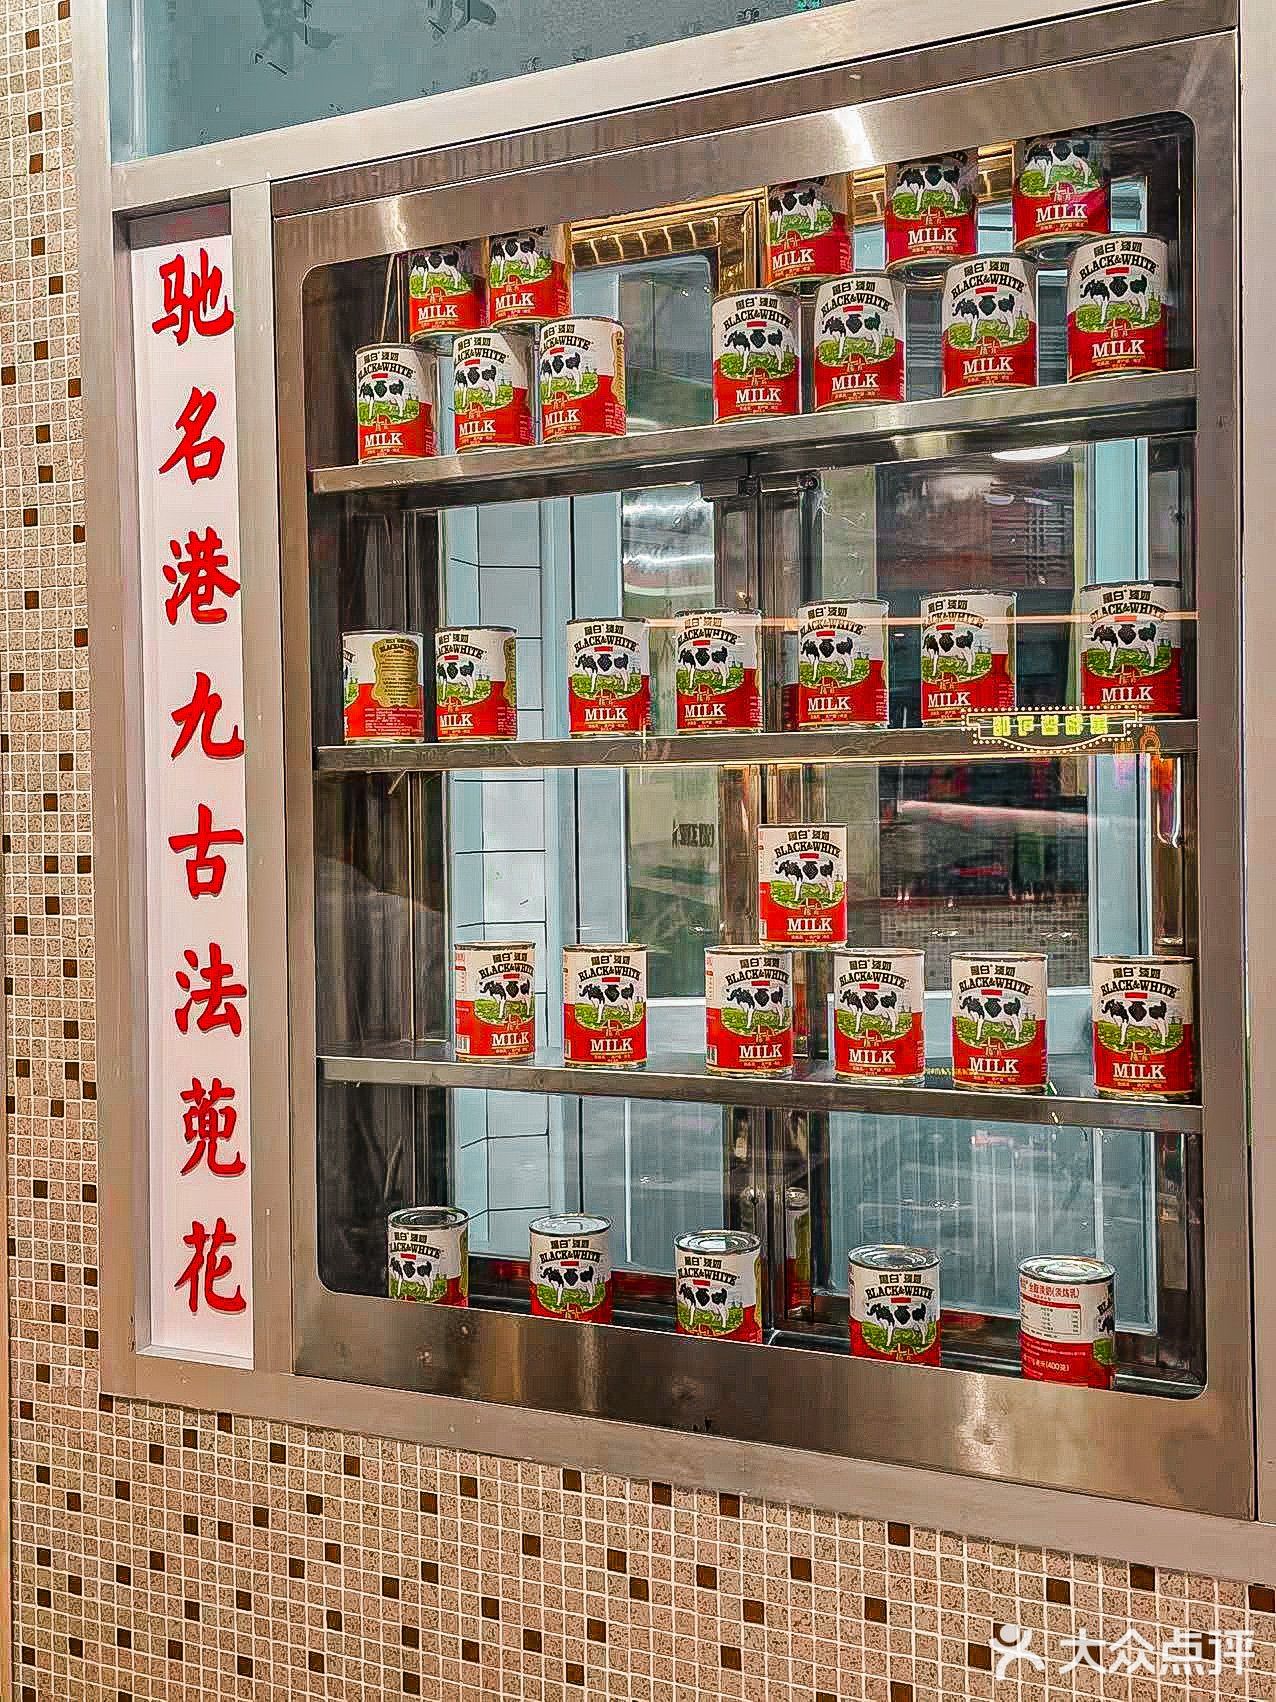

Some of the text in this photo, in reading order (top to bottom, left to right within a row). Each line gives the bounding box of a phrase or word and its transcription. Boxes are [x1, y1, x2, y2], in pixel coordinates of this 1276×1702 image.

[1036, 203, 1087, 223] MILK
[908, 227, 957, 246] MILK
[772, 249, 815, 270] MILK
[1079, 253, 1157, 281] BLACK&WHITE
[951, 273, 1025, 300] BLACK&WHITE
[495, 293, 534, 310] MILK
[821, 293, 892, 316] BLACK&WHITE
[418, 304, 458, 320] MILK
[723, 308, 793, 330] BLACK&WHITE
[540, 336, 591, 354] ACK&WHITE
[1092, 339, 1145, 360] MILK
[454, 348, 506, 365] ACK&WHITE
[963, 356, 1014, 375] MILK
[831, 373, 879, 392] MILK
[735, 387, 782, 403] MILK
[544, 409, 580, 428] MILK
[459, 420, 496, 436] MILK
[364, 433, 403, 446] MILK
[1089, 602, 1168, 624] BLACK&WHITE
[437, 643, 485, 659] ACK&WHITE
[574, 635, 637, 652] BLACK&WHITE
[928, 691, 971, 707] MILK
[1101, 686, 1154, 702] MILK
[685, 703, 726, 718] MILK
[807, 696, 851, 711] MILK
[439, 713, 473, 728] MILK
[585, 707, 628, 721] MILK
[774, 841, 841, 858] BLACK&WHITE
[786, 917, 832, 932] MILK
[578, 966, 642, 982] BLACK&WHITE
[839, 971, 906, 989] BLACK&WHITE
[959, 977, 1030, 996] BLACK&WHITE
[1101, 980, 1178, 999] BLACK&WHITE
[491, 1031, 530, 1046] MILK
[590, 1037, 633, 1052] MILK
[739, 1043, 783, 1059] MILK
[848, 1048, 896, 1064] MILK
[969, 1056, 1020, 1074] MILK
[1113, 1063, 1167, 1080] MILK
[391, 1242, 440, 1259] LACK&WHITE
[539, 1250, 600, 1264] BLACK&WHITE
[865, 1285, 935, 1300] BLACK&WHITE
